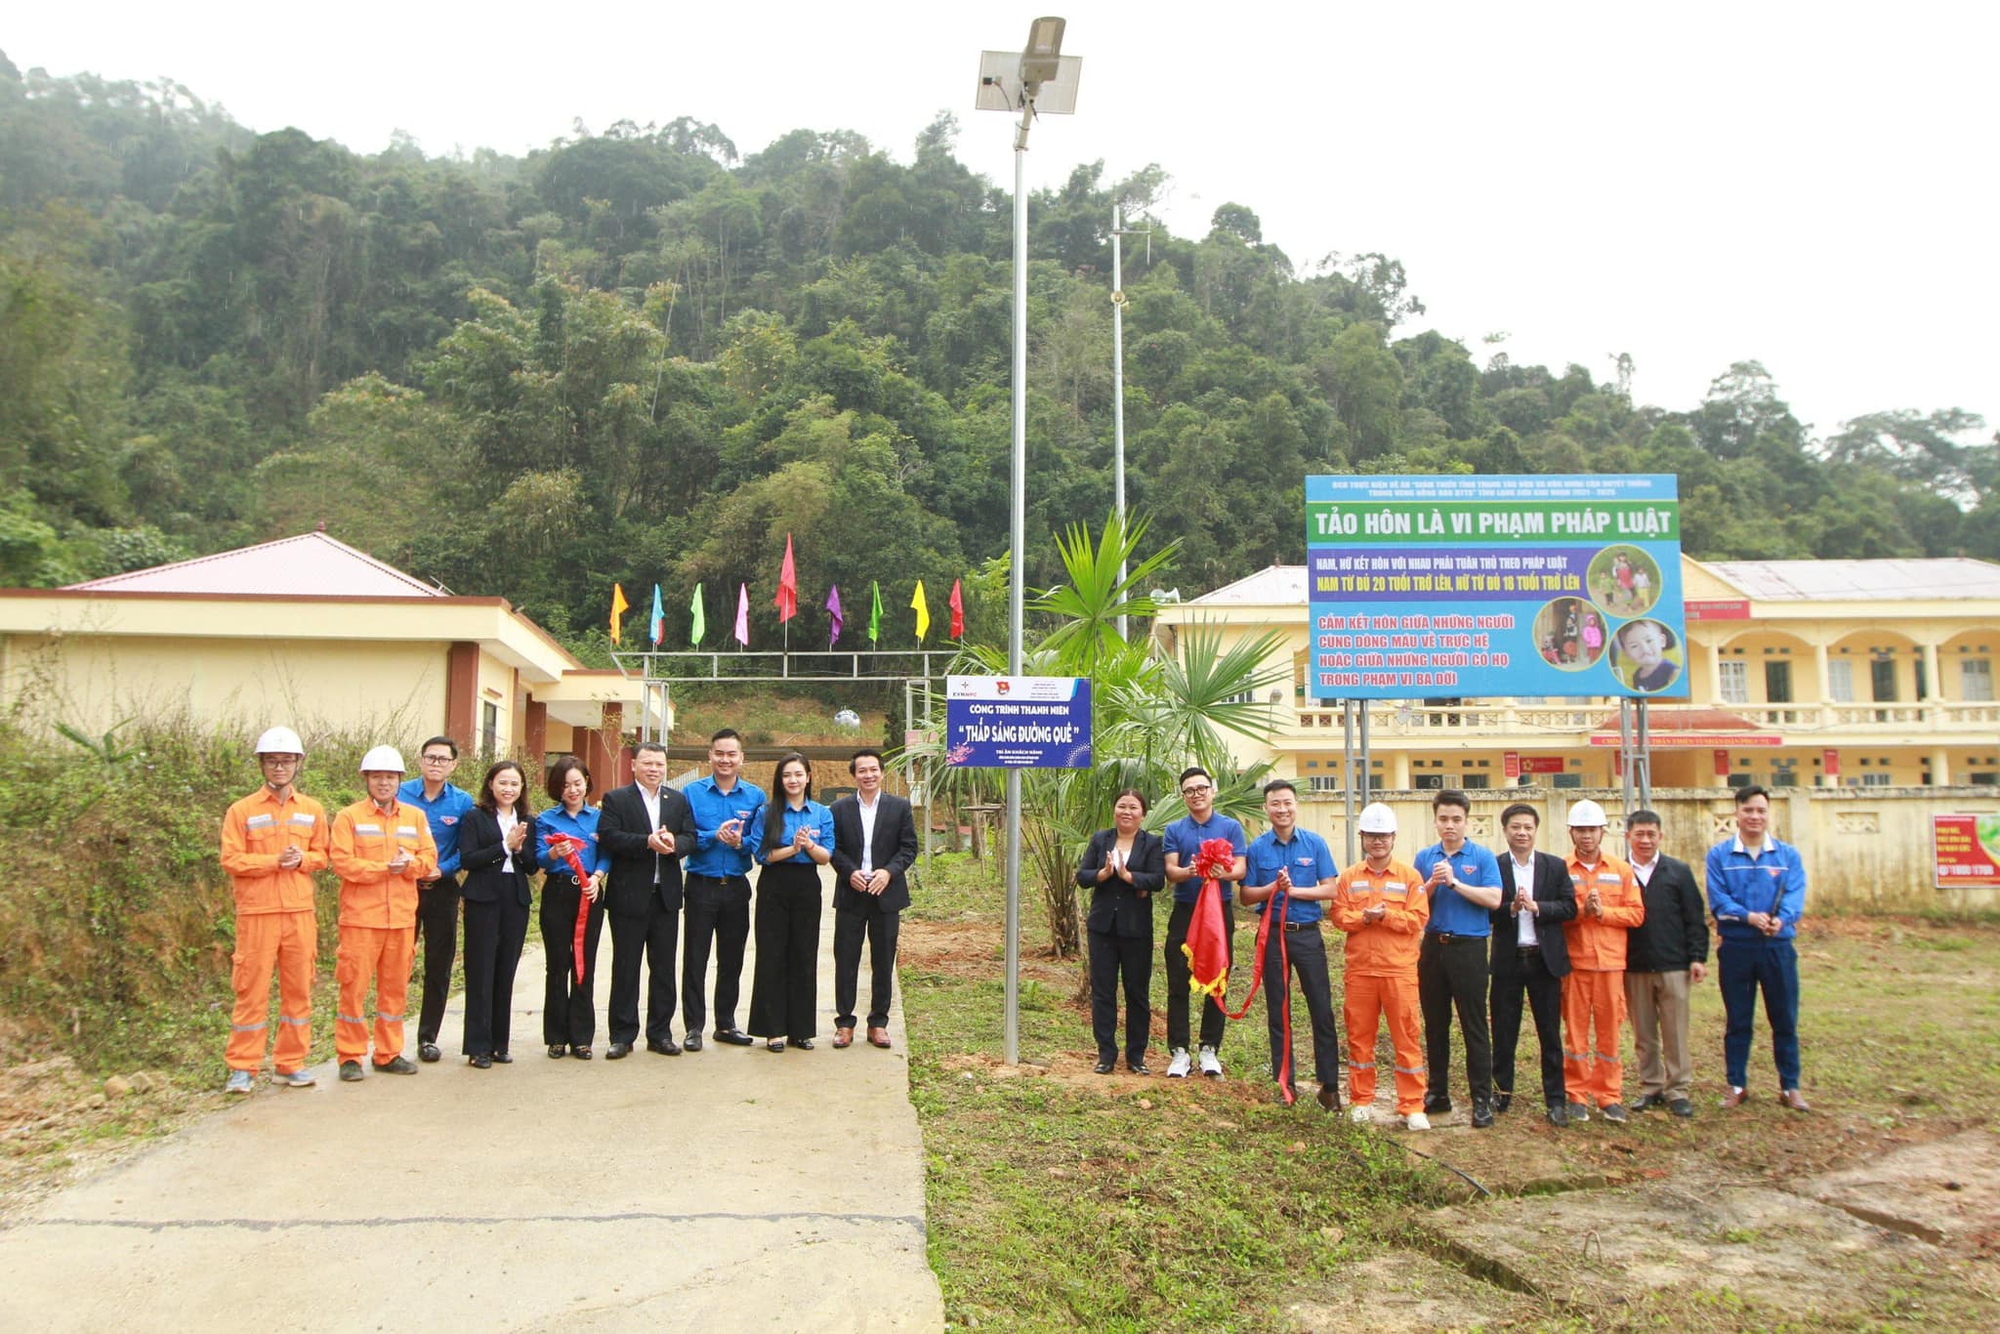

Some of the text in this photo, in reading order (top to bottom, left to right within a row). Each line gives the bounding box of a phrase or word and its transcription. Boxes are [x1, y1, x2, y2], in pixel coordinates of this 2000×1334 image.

[1315, 506, 1671, 539] TẢO HÔN LÀ VI PHẠM PHÁP LUẬT
[1499, 556, 1521, 569] THEO
[1522, 555, 1545, 569] PHÁP
[1547, 555, 1567, 571] LUẬT
[1317, 576, 1339, 591] NAM
[1373, 576, 1386, 591] 20
[1319, 672, 1360, 686] TRONG
[1362, 672, 1397, 688] PHẠM
[1399, 672, 1413, 686] VI
[1416, 672, 1432, 686] BA
